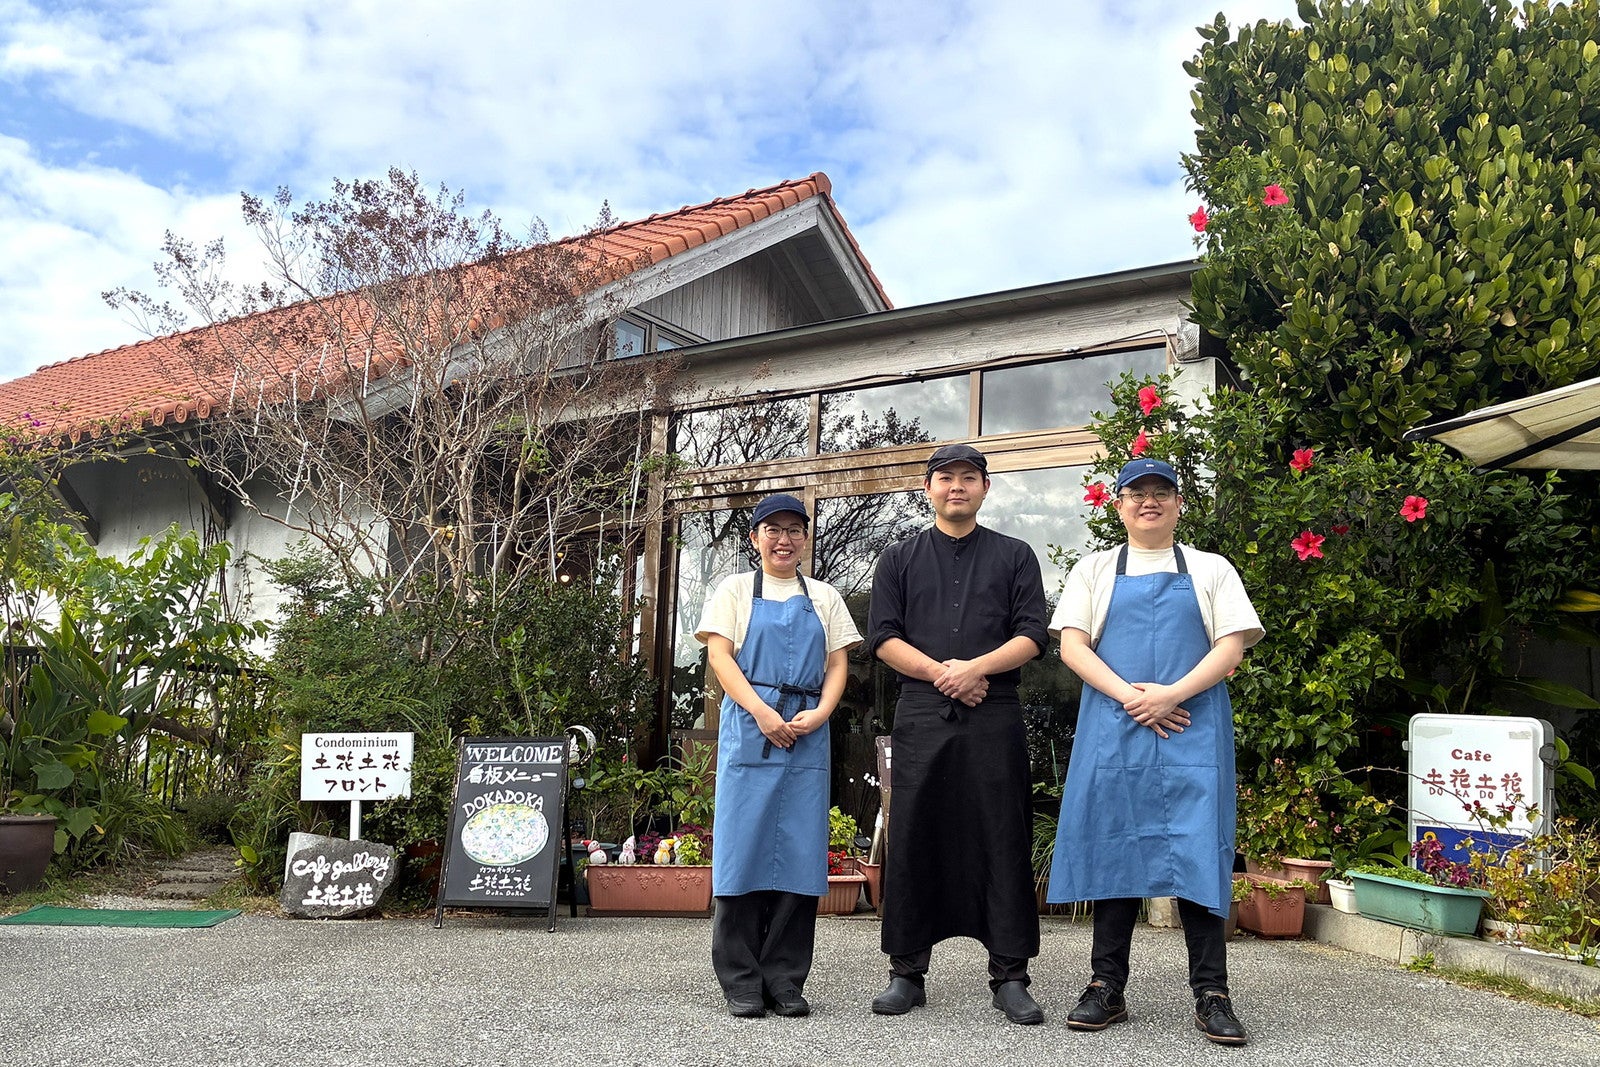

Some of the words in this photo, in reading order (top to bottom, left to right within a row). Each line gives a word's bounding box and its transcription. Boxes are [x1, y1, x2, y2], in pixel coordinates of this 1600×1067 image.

[315, 737, 398, 748] Condominium
[312, 751, 400, 771] 土花土花
[465, 745, 562, 762] WELCOME
[1451, 749, 1492, 762] Cafe
[463, 764, 558, 785] 看板メニュー
[1421, 768, 1522, 792] 土花土花
[324, 777, 387, 793] フロント
[1429, 786, 1444, 796] DO
[1455, 788, 1470, 798] KA
[1479, 790, 1494, 799] DO
[462, 789, 544, 818] DOKADOKA
[331, 852, 391, 881] gallery
[468, 873, 532, 892] 土花土花
[301, 882, 374, 906] 土花土花
